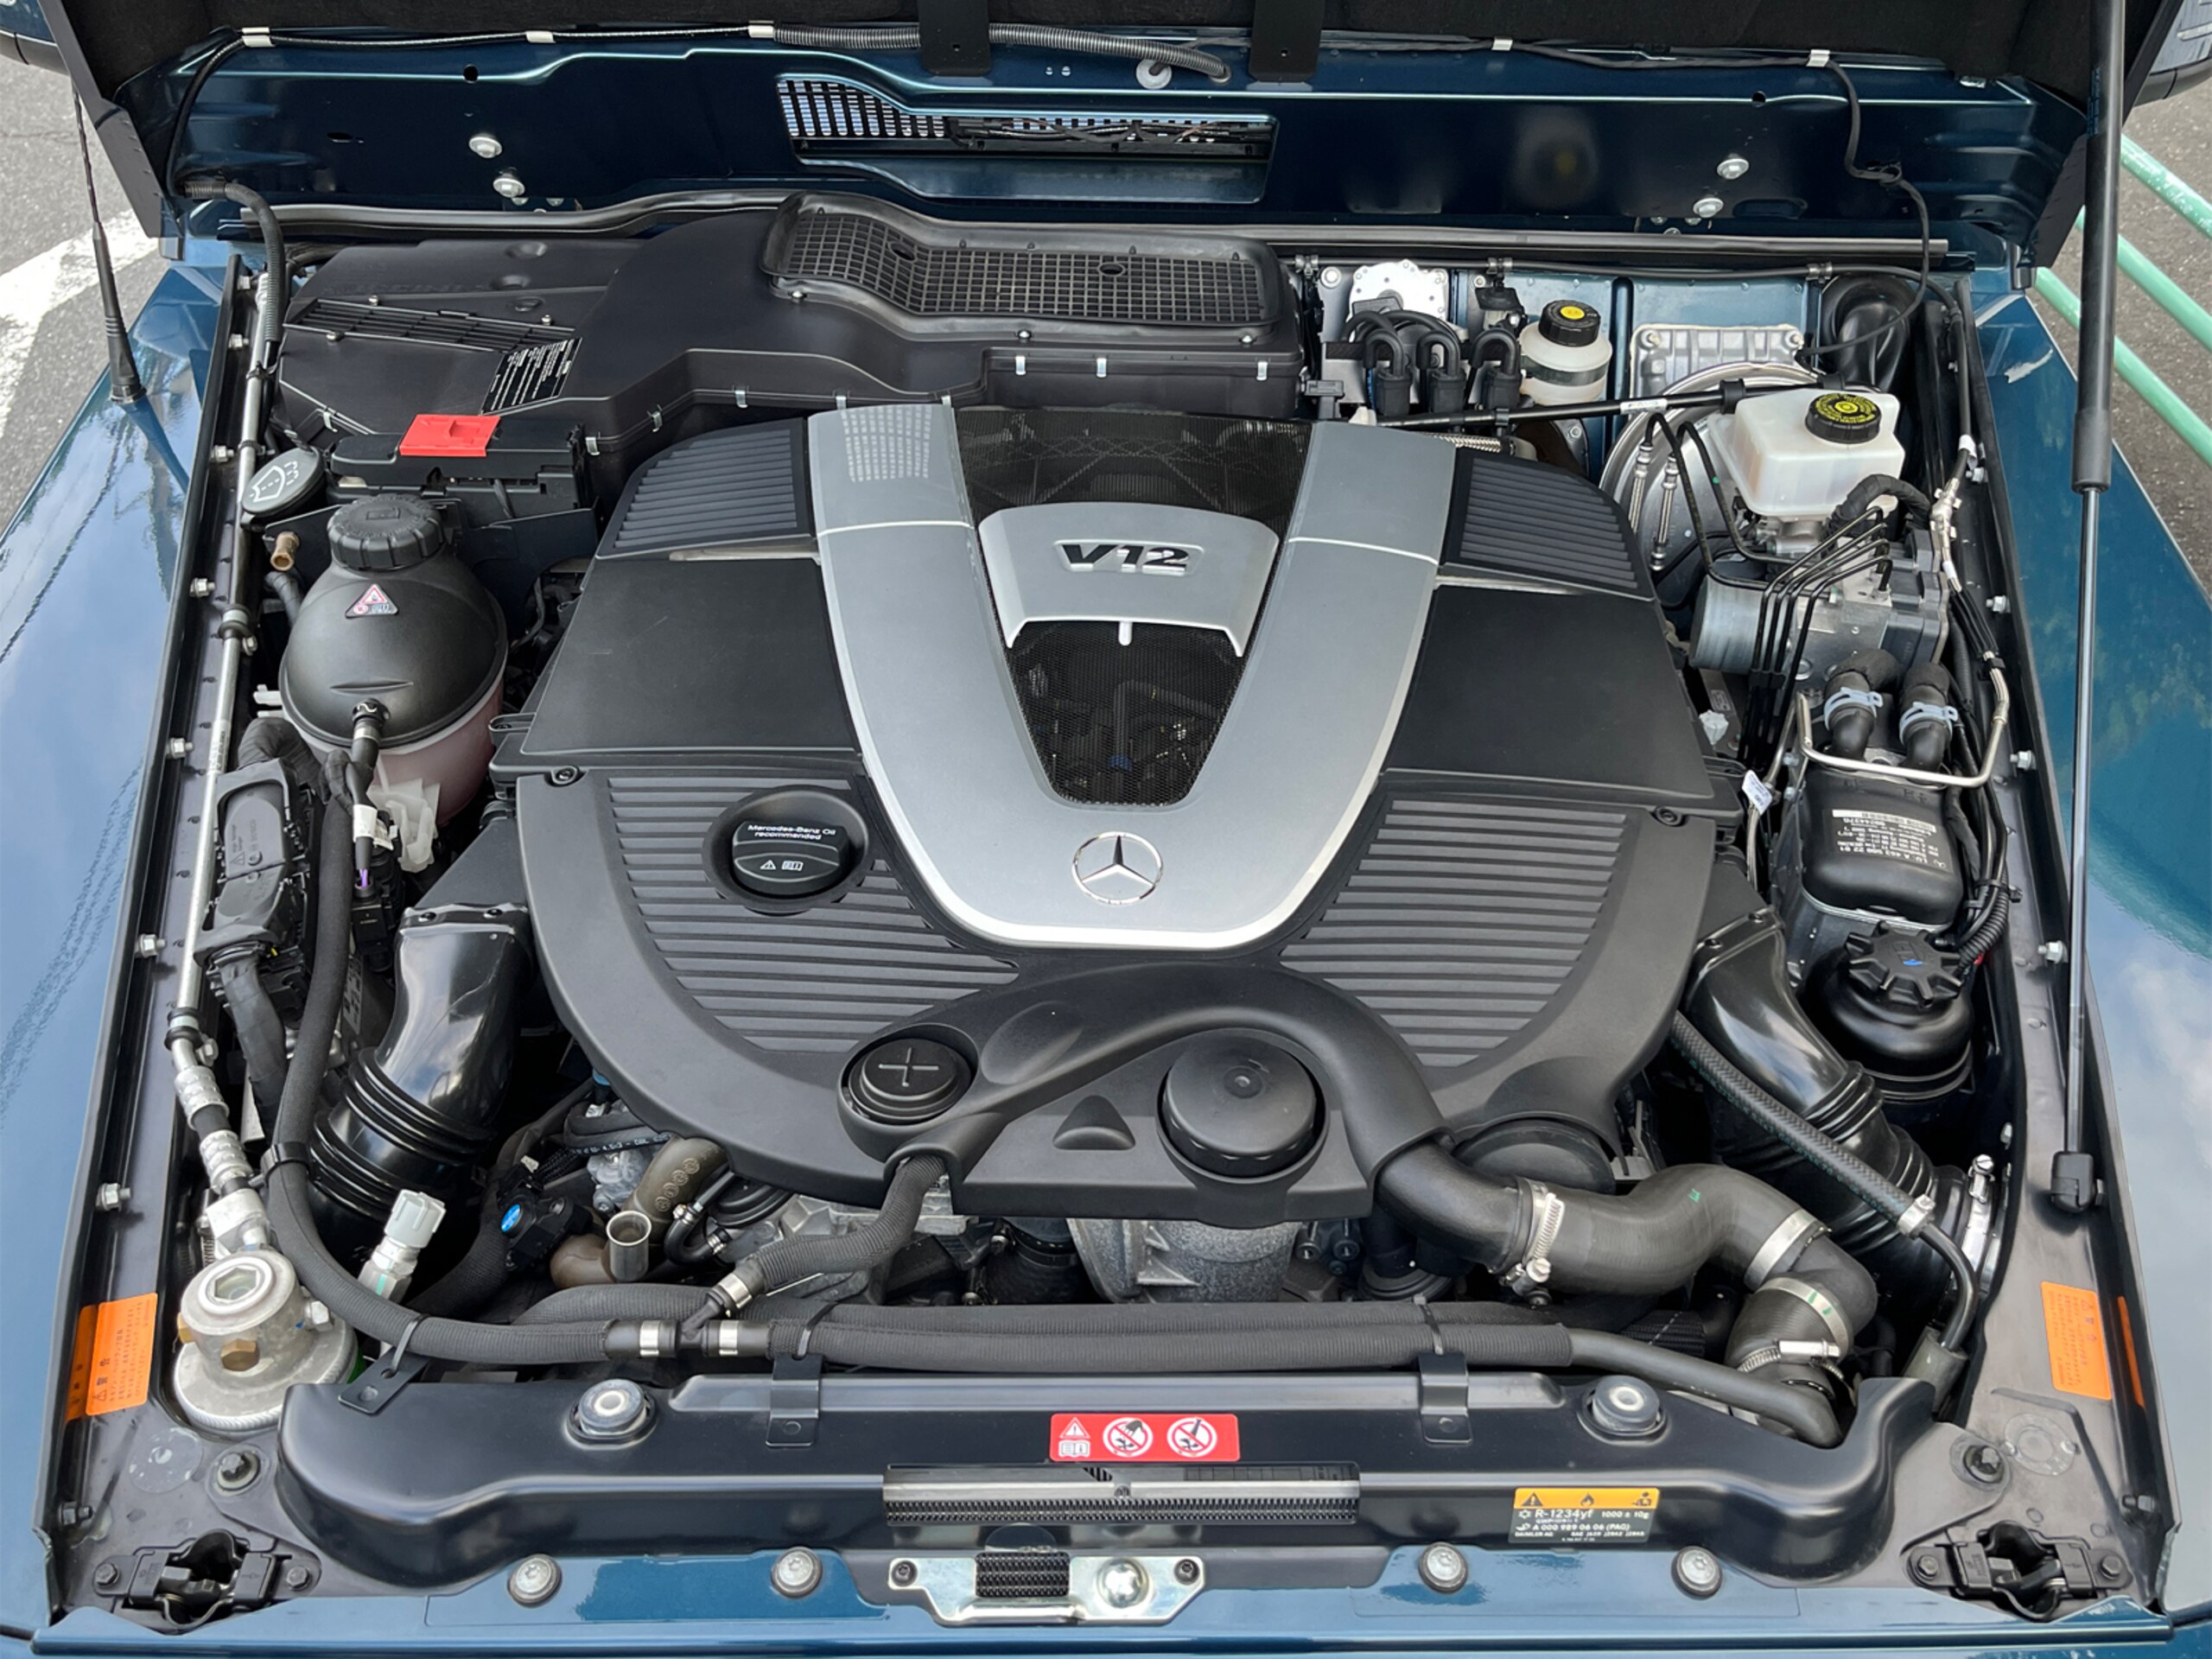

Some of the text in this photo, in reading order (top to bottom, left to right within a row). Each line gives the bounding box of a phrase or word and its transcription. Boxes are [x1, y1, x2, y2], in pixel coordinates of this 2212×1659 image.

[1061, 544, 1190, 576] V12
[747, 824, 820, 834] Mercedes-Benz
[754, 831, 822, 840] recommended
[1535, 1509, 1593, 1520] R-1234yf
[1633, 1510, 1649, 1520] 10g
[1606, 1522, 1631, 1532] (PAG)
